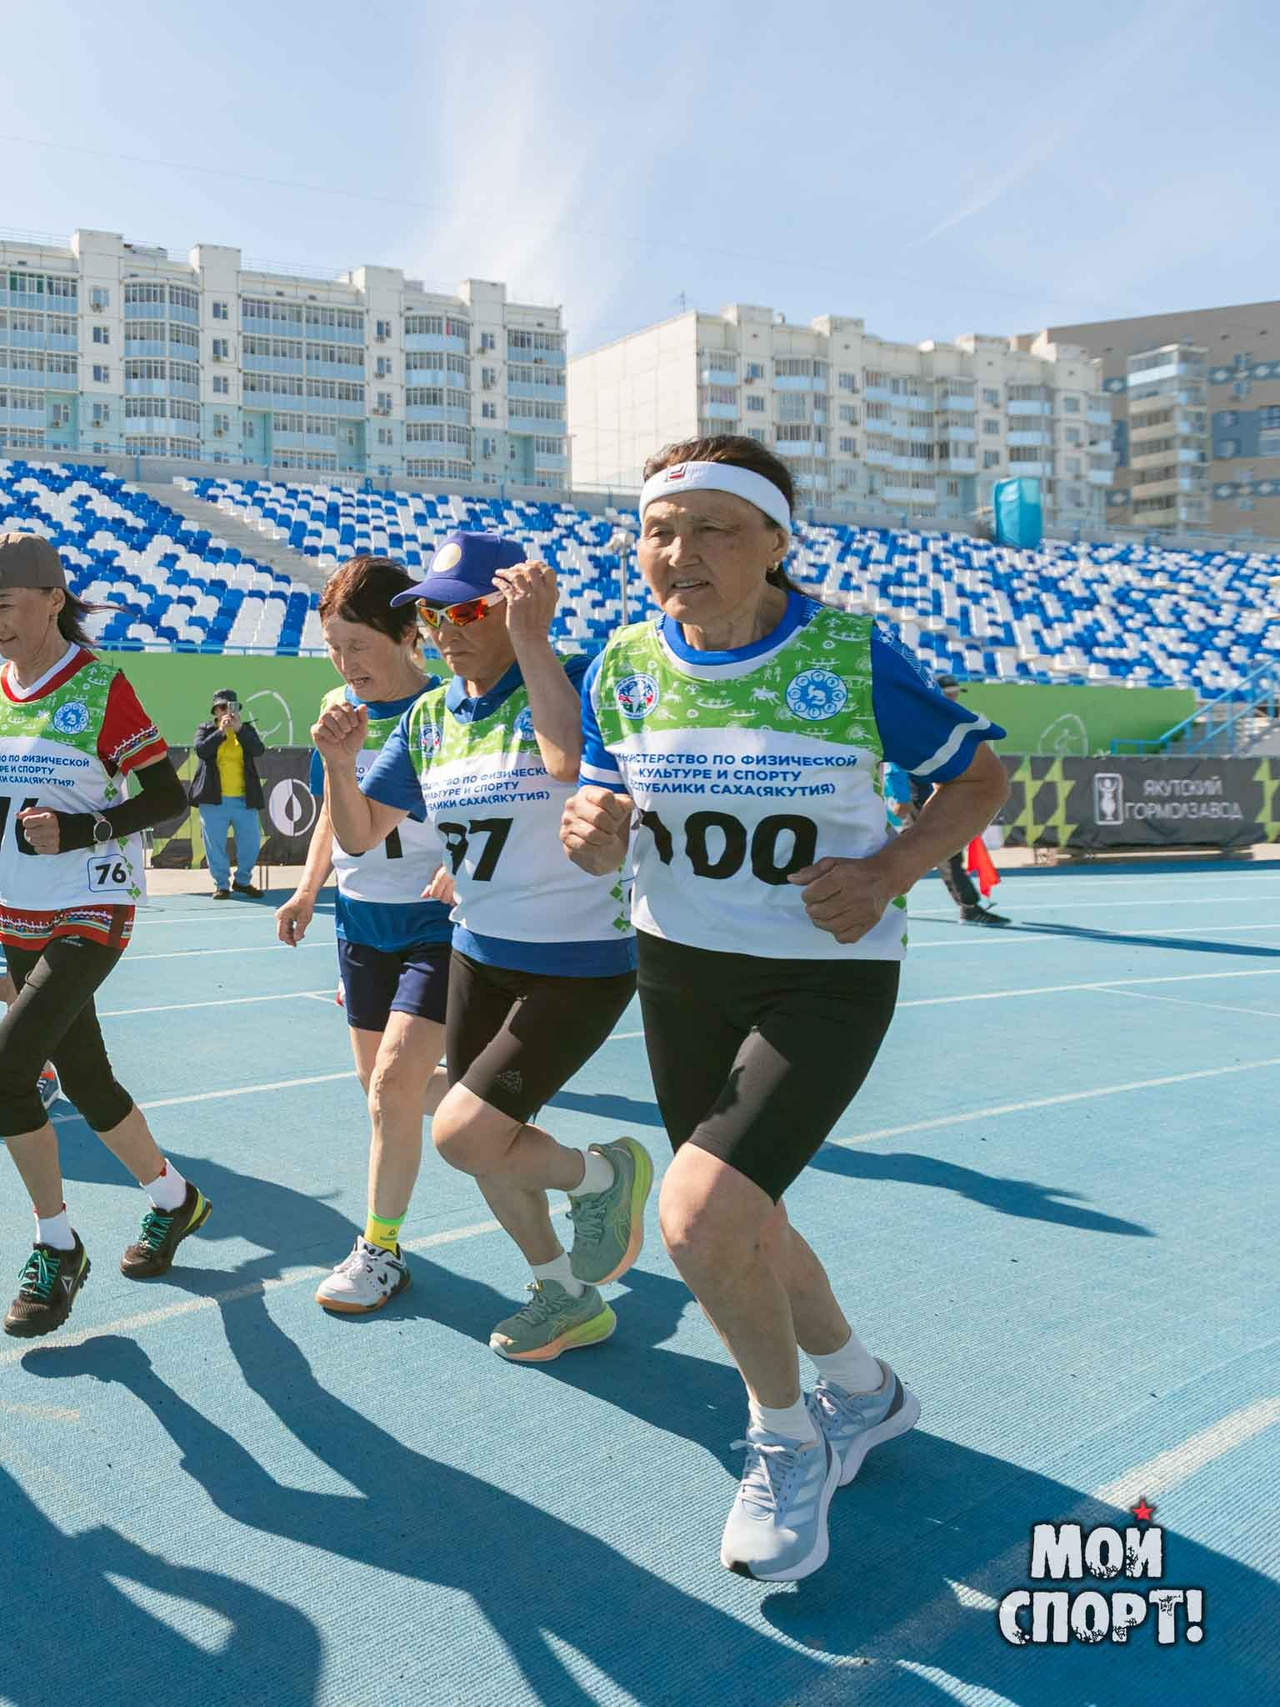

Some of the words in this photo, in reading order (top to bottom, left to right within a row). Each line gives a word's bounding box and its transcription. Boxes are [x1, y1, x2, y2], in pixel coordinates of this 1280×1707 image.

[22, 755, 90, 767] ФИЗИЧЕСКОЙ
[713, 755, 736, 765] ПО
[741, 755, 858, 767] ФИЗИЧЕСКОЙ
[10, 765, 17, 773] И
[18, 766, 55, 775] СПОРТУ
[462, 775, 478, 784] ПО
[480, 767, 547, 781] ФИЗИЧЕСК
[639, 767, 712, 779] КУЛЬТУРЕ
[717, 770, 728, 779] И
[733, 770, 802, 782] СПОРТУ
[9, 776, 75, 787] САХА(ЯКУТИЯ)
[474, 781, 519, 793] СПОРТУ
[1143, 775, 1223, 796] ЯКУТСКИЙ
[710, 783, 836, 797] САХА(ЯКУТИЯ)
[459, 790, 550, 807] САХА(ЯКУТИЯ)
[1125, 801, 1243, 820] ГОРМОЛЗАВОД
[95, 863, 127, 884] 76
